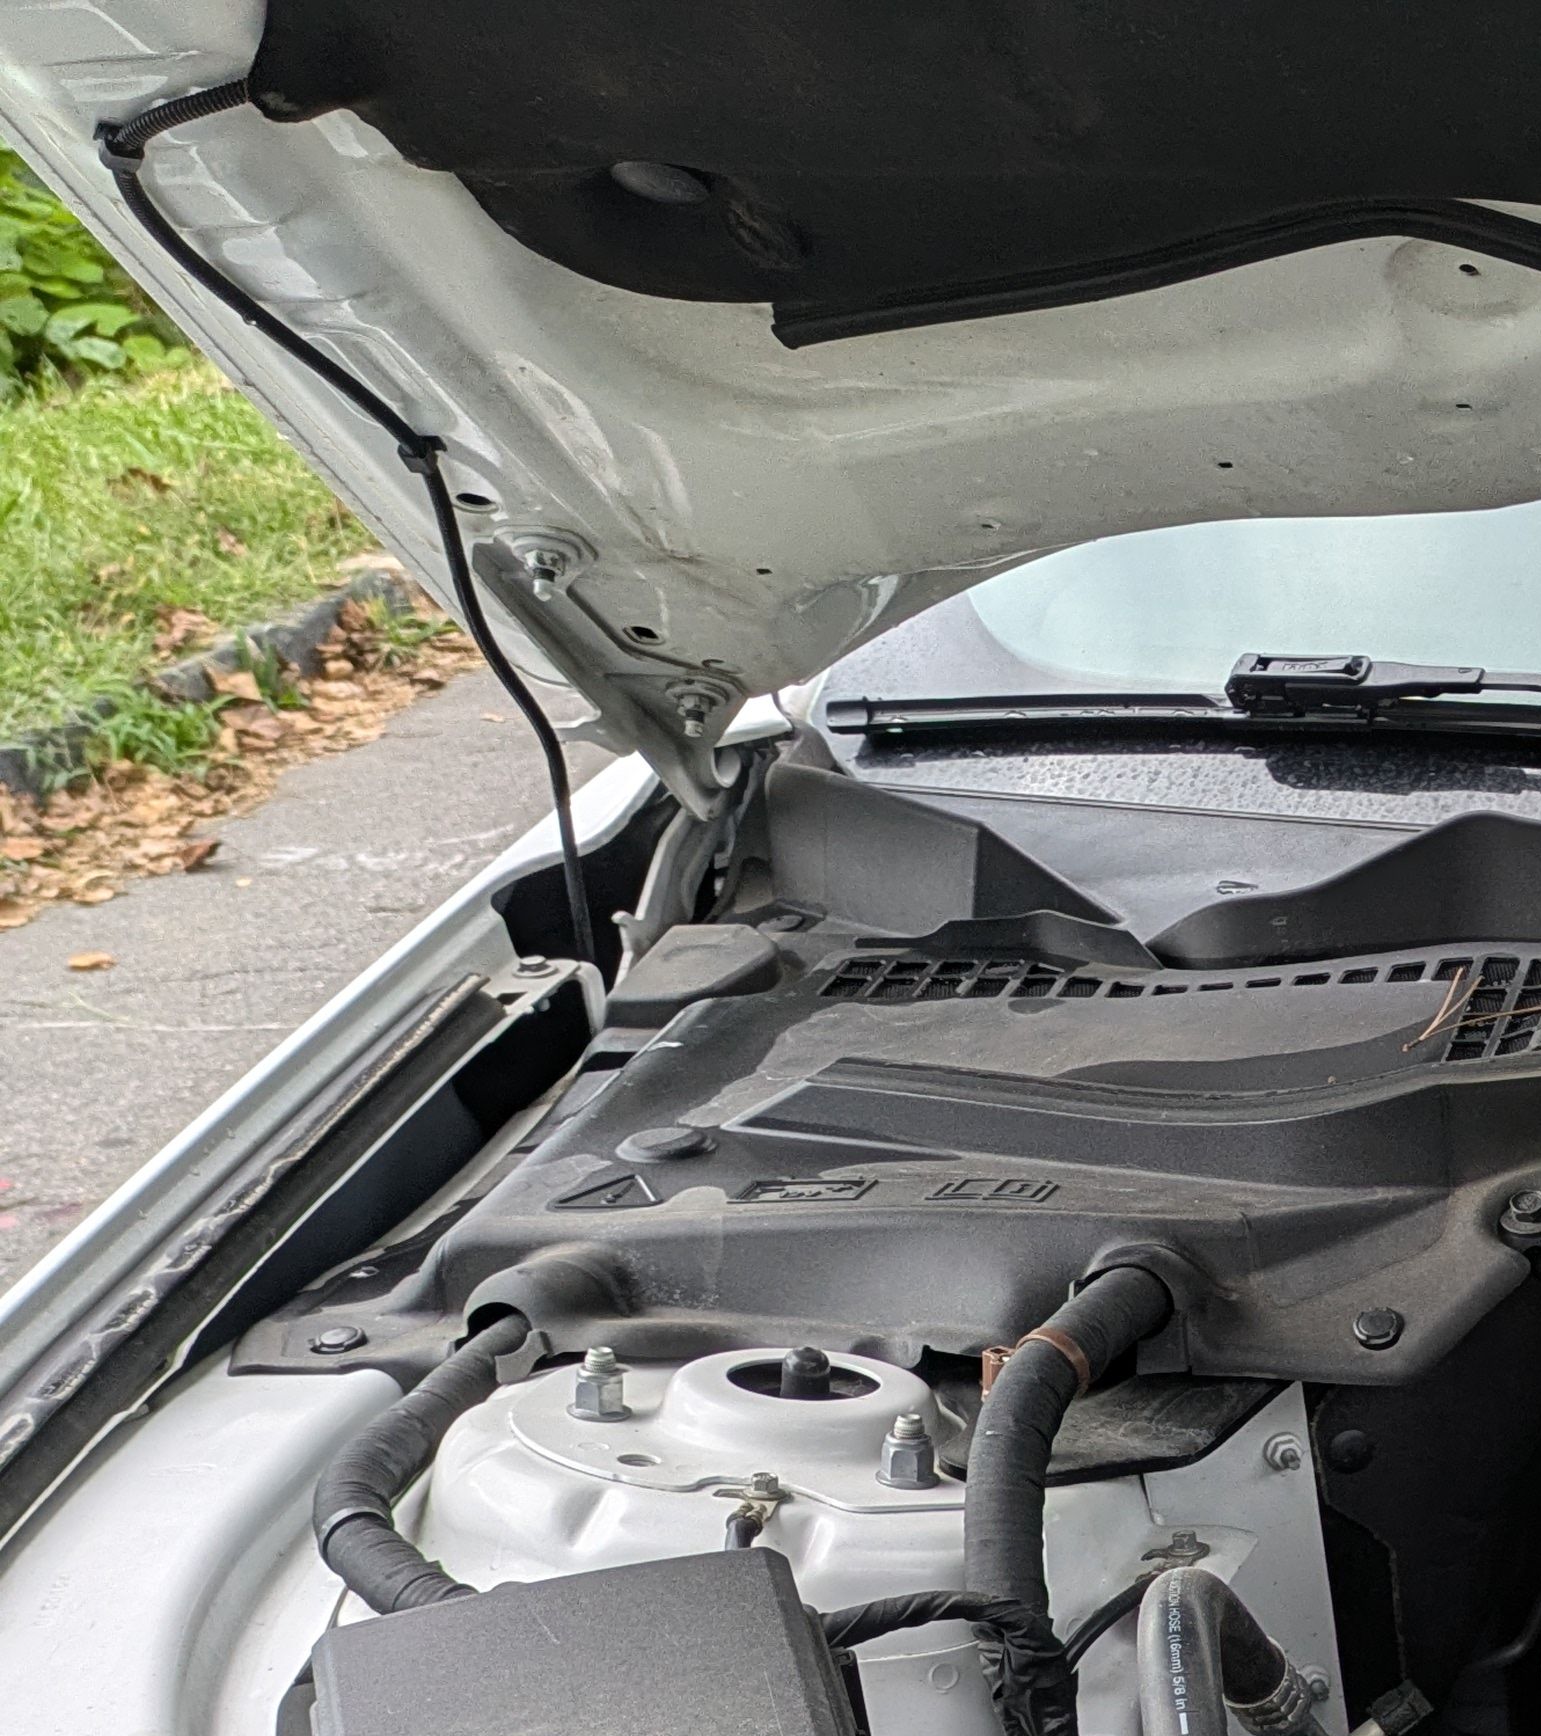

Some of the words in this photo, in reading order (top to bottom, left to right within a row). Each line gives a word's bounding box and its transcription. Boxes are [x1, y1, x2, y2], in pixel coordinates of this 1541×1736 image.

[1168, 1608, 1182, 1633] HOSE
[1168, 1635, 1184, 1674] (16mm)
[1173, 1676, 1187, 1696] 5/8
